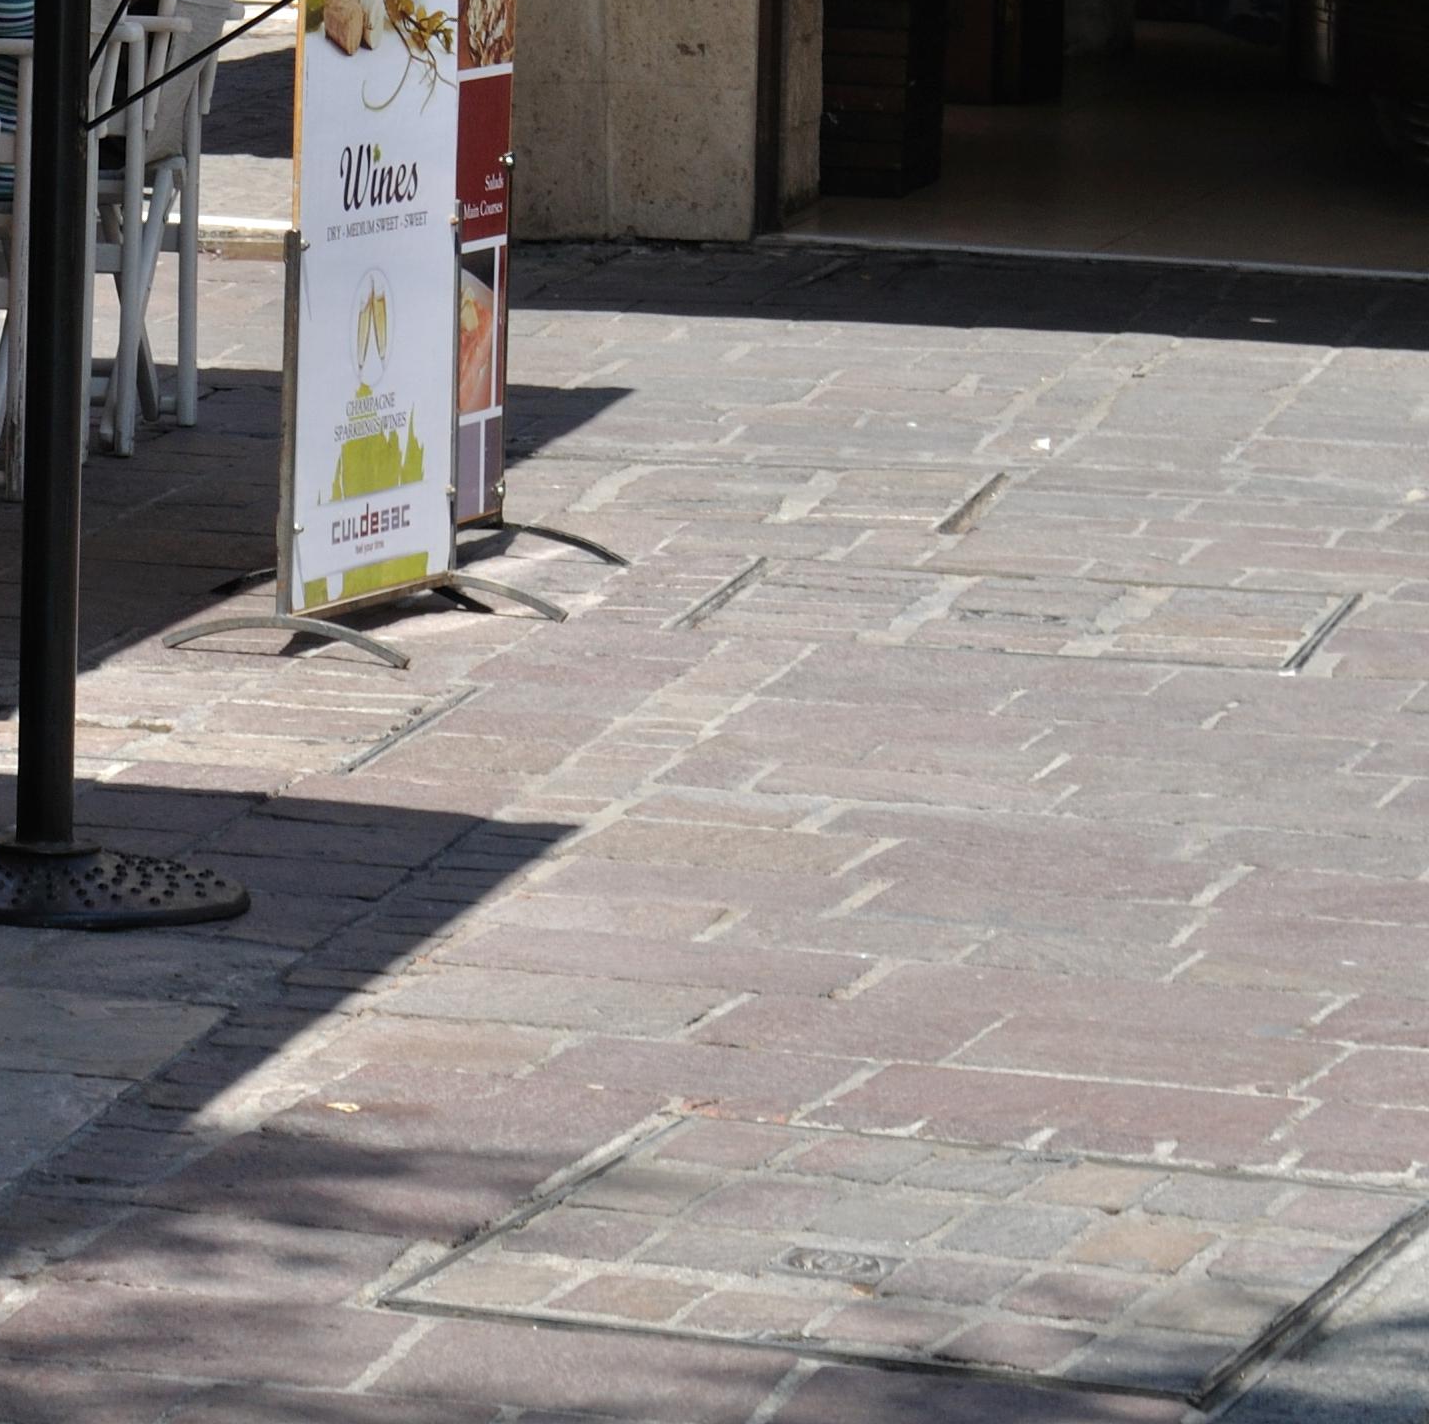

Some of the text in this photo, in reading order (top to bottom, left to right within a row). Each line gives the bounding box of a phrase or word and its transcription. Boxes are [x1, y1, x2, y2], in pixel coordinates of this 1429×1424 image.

[340, 143, 419, 212] Wines
[345, 220, 375, 237] MEDIUM
[375, 215, 399, 232] SWEET
[404, 211, 428, 228] SWEET
[345, 391, 396, 418] CHAMPAGNE
[331, 503, 411, 545] culdesac
